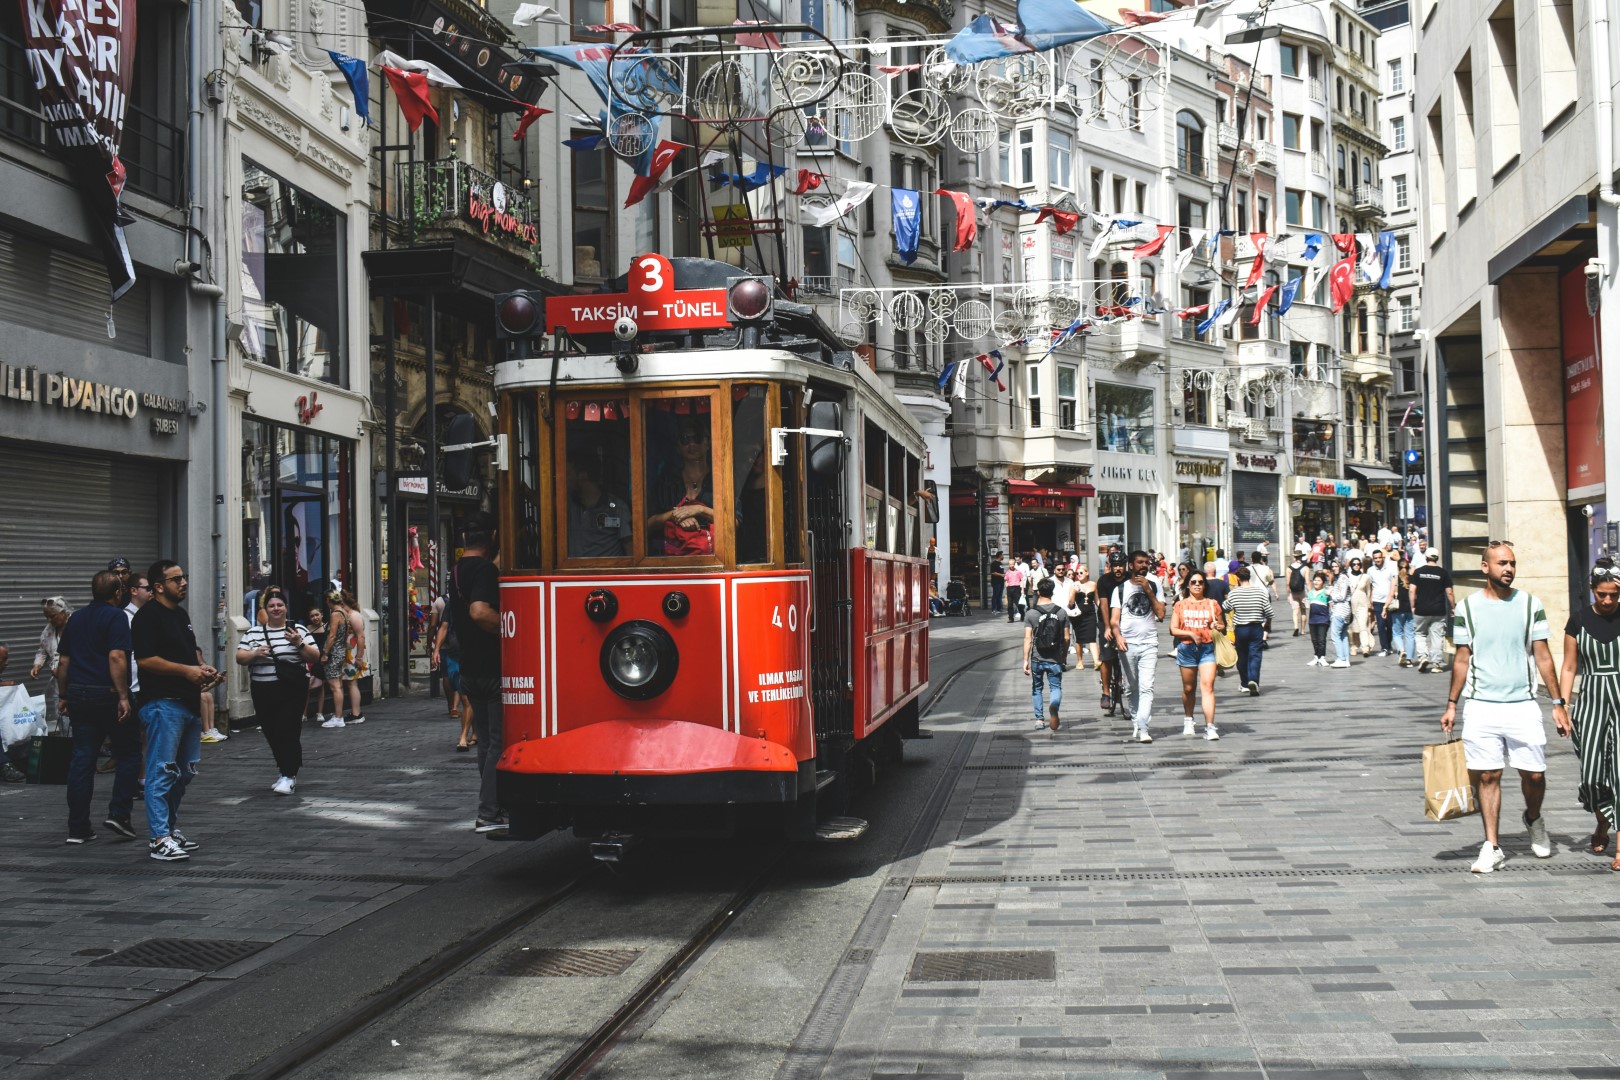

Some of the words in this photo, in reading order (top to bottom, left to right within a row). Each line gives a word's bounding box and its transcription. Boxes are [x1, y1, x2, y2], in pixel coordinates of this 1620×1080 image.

[723, 237, 747, 247] VOLT
[639, 257, 664, 292] 3
[571, 302, 638, 322] TAKSİM
[663, 300, 723, 318] TÜNEL
[1183, 609, 1210, 618] SQUAD
[1184, 619, 1208, 628] GOALS
[512, 677, 534, 688] YASAK
[748, 690, 759, 703] VE
